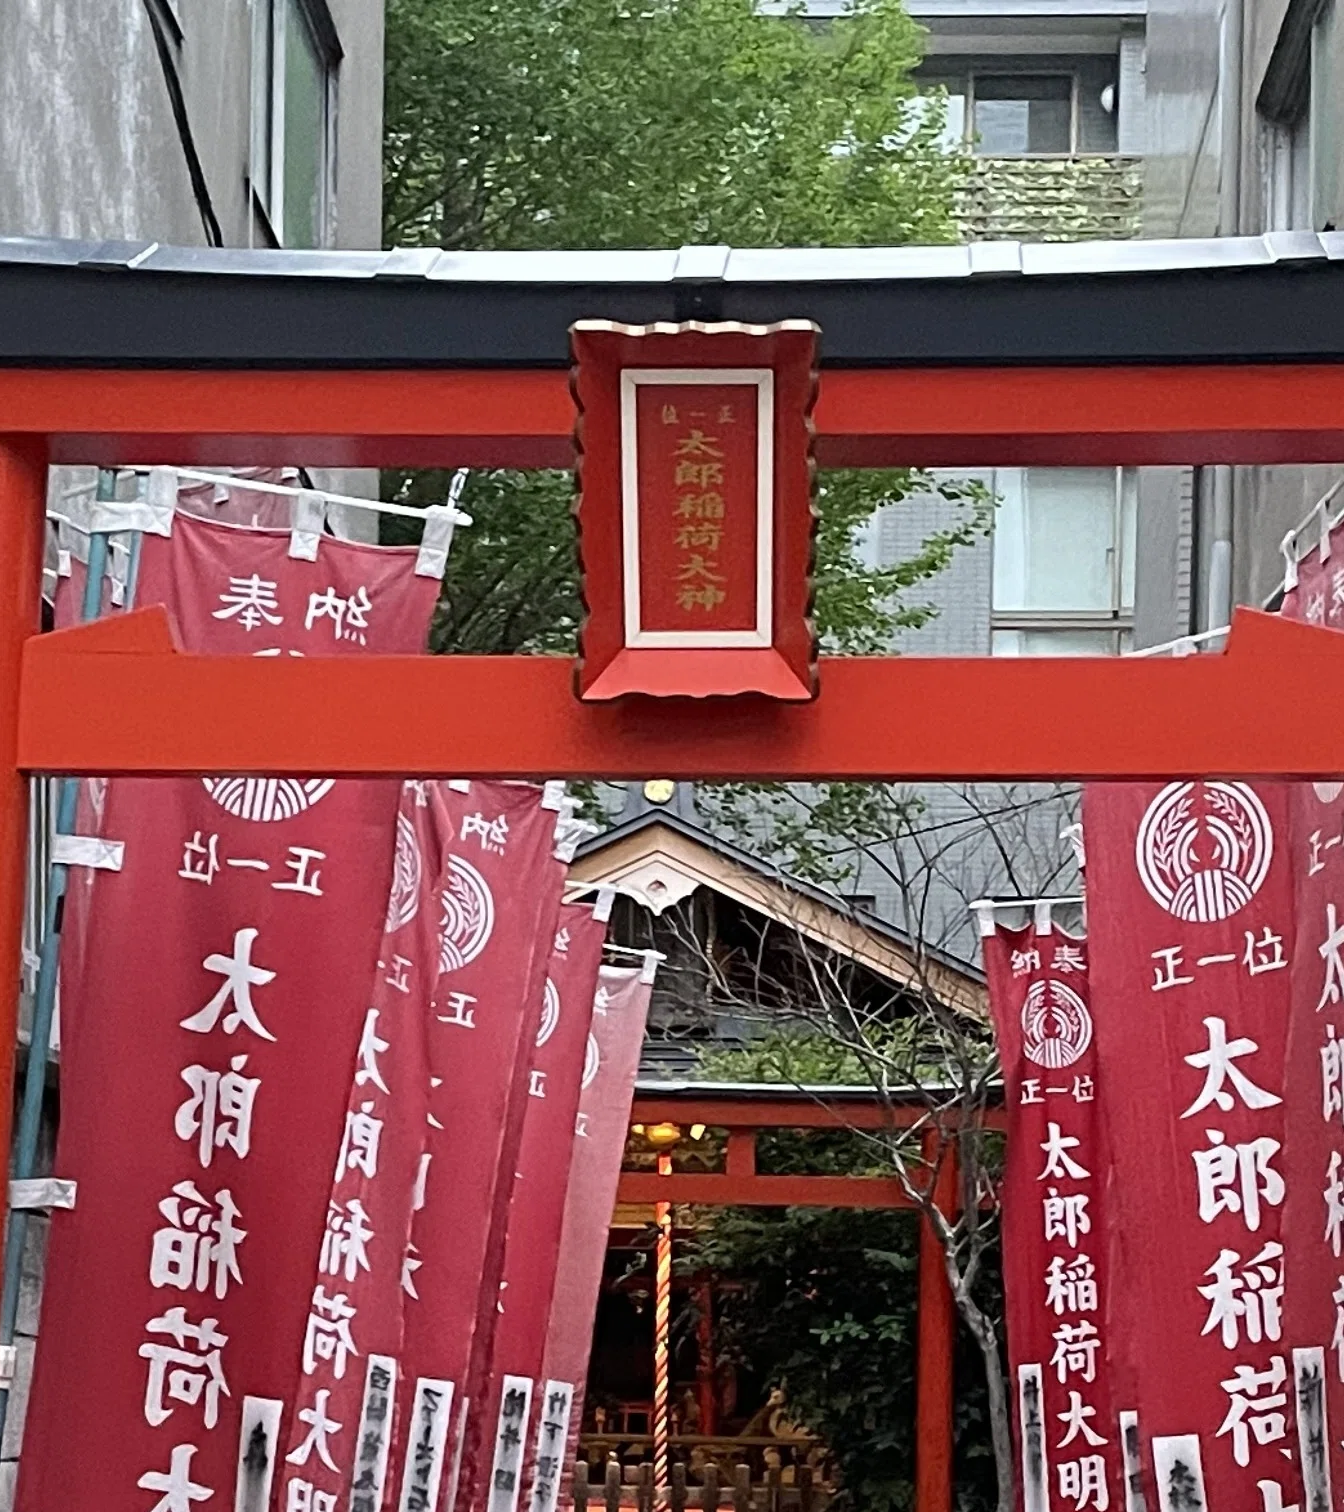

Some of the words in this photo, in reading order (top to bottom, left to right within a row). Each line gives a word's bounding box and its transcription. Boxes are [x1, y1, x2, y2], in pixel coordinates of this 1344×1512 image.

[671, 429, 727, 613] 太郎稲荷大神
[1150, 926, 1288, 993] 正一位
[1020, 1074, 1094, 1105] 正一位
